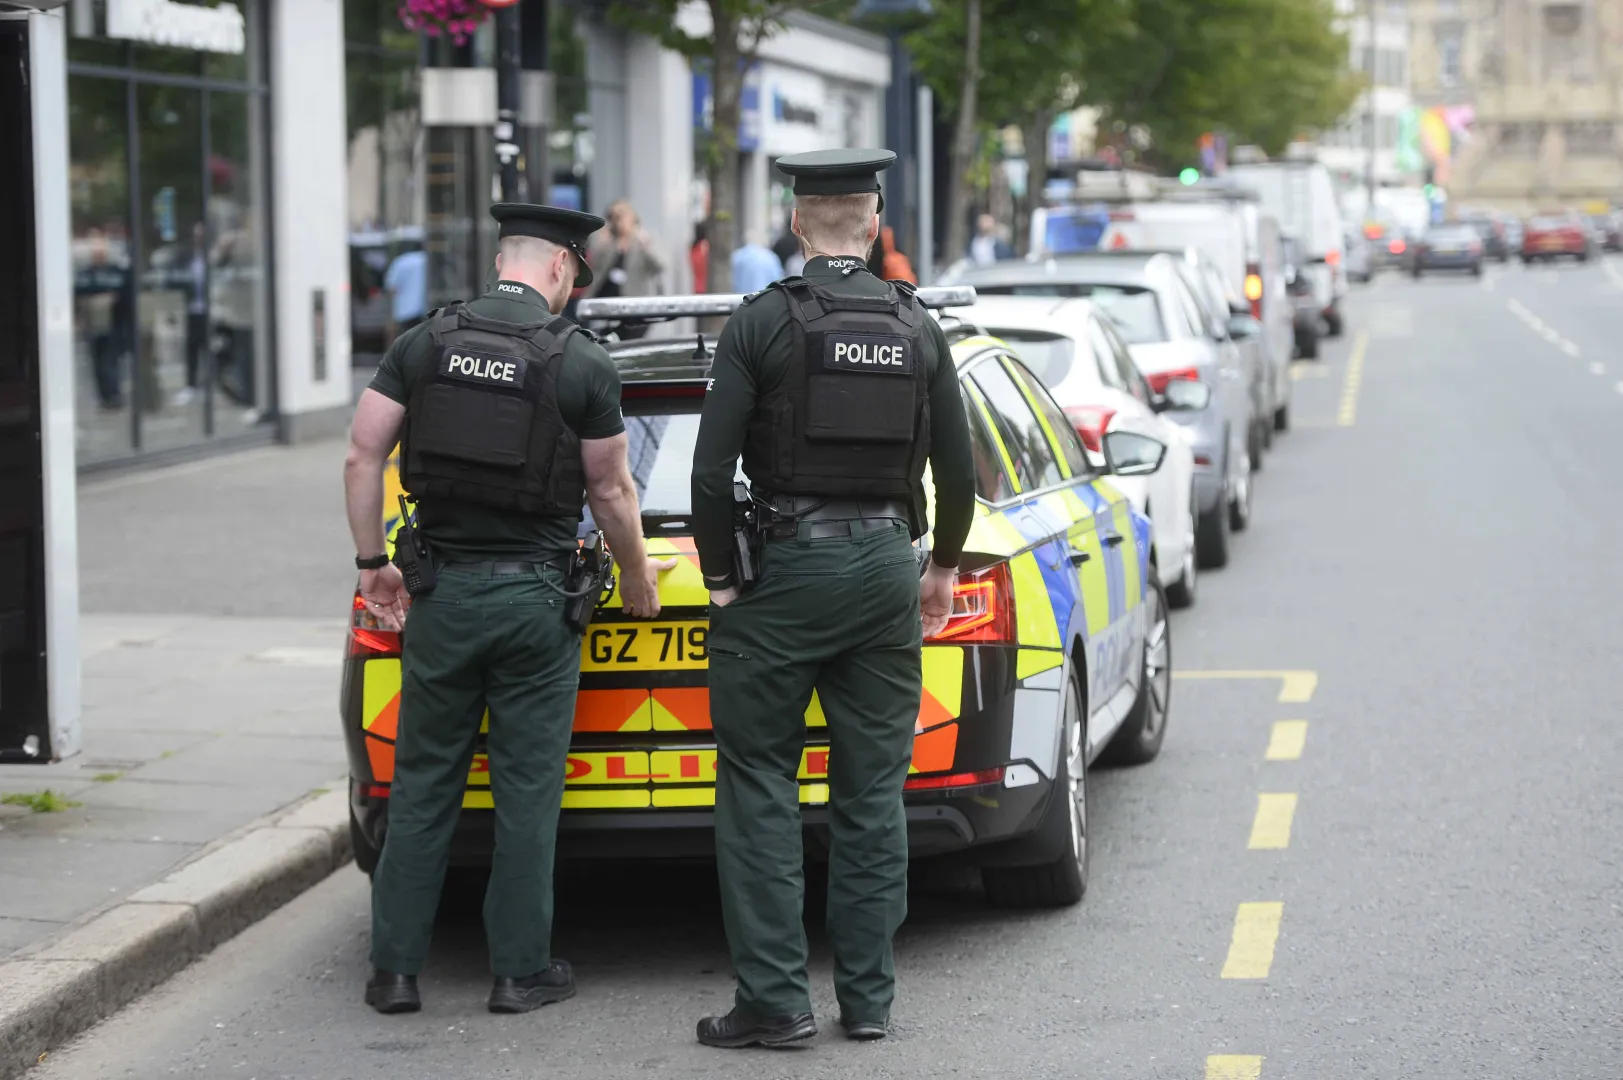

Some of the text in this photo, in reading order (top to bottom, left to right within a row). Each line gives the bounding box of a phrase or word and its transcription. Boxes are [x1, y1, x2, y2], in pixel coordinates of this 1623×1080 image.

[497, 284, 524, 295] POLICE
[834, 342, 903, 366] POLICE
[447, 354, 517, 382] POLICE
[582, 629, 638, 664] GZ
